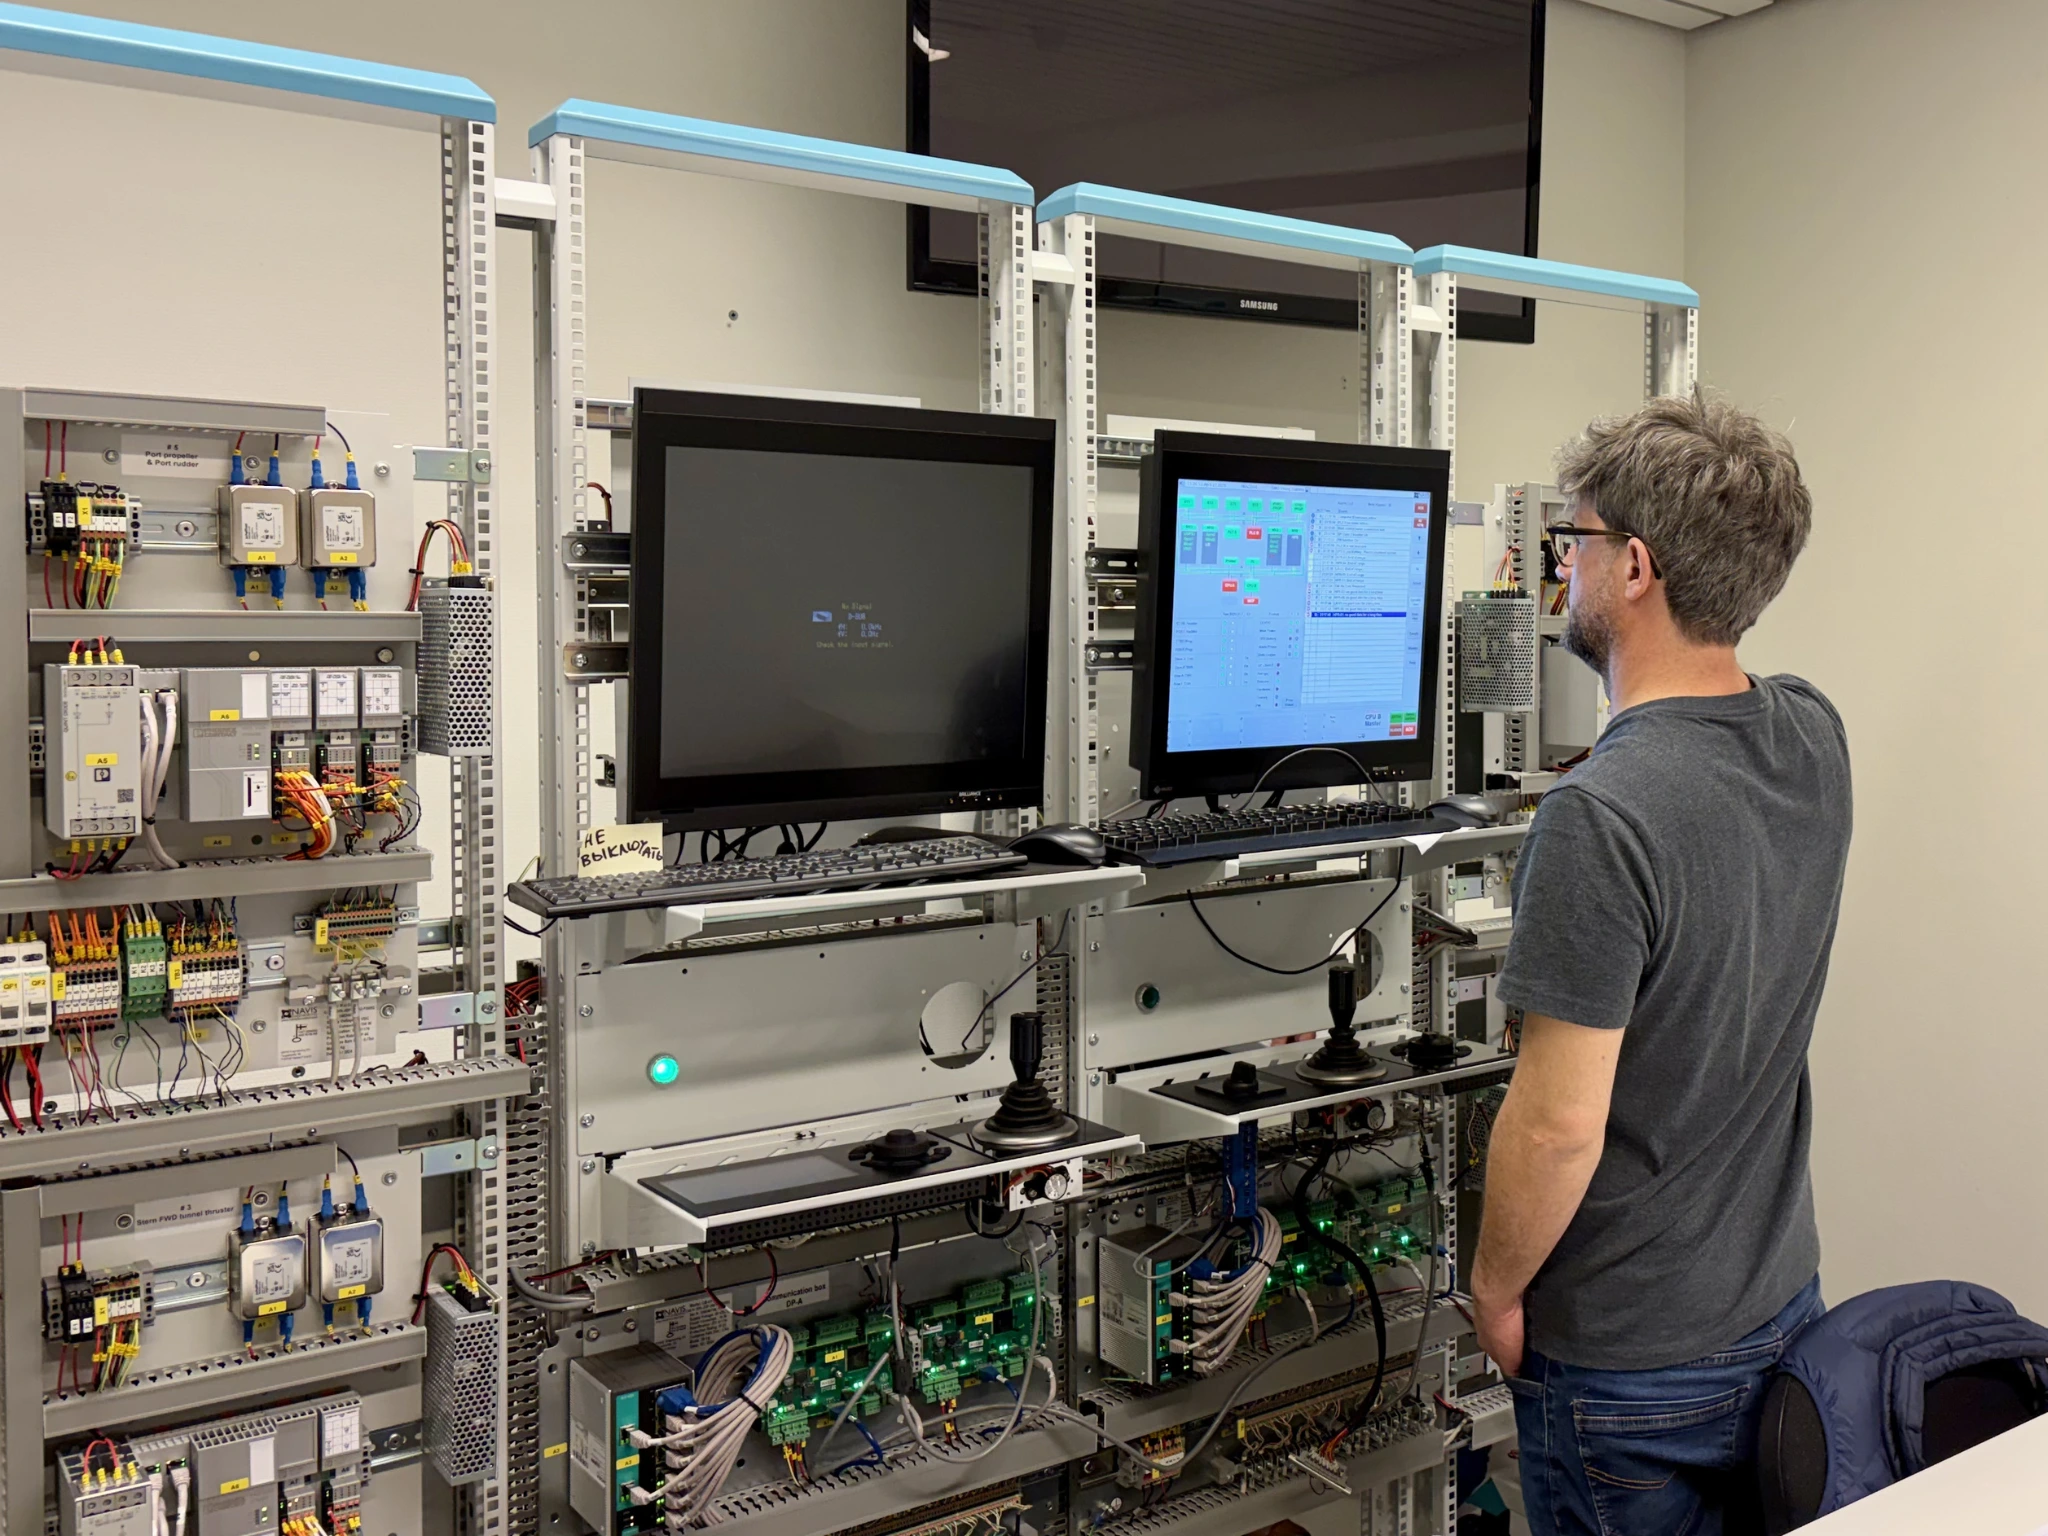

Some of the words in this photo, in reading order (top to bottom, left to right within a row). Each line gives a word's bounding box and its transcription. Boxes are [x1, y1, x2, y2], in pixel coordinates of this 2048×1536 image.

[1240, 299, 1278, 311] SAMSUNG
[163, 452, 198, 460] propeller
[173, 460, 199, 468] rudder
[841, 602, 849, 610] No
[584, 829, 605, 848] НЕ
[581, 840, 664, 867] ВЫКЛЮЧАТЬ
[131, 966, 137, 975] K1
[140, 965, 147, 973] K2
[159, 963, 164, 972] K4
[291, 1006, 318, 1015] NAVIS
[136, 1218, 158, 1226] Stern
[159, 1214, 177, 1222] FWD
[179, 1210, 203, 1219] tunnel
[205, 1206, 234, 1216] thruster
[767, 1287, 813, 1302] ommunication
[814, 1283, 826, 1292] box
[786, 1298, 803, 1308] DP-A
